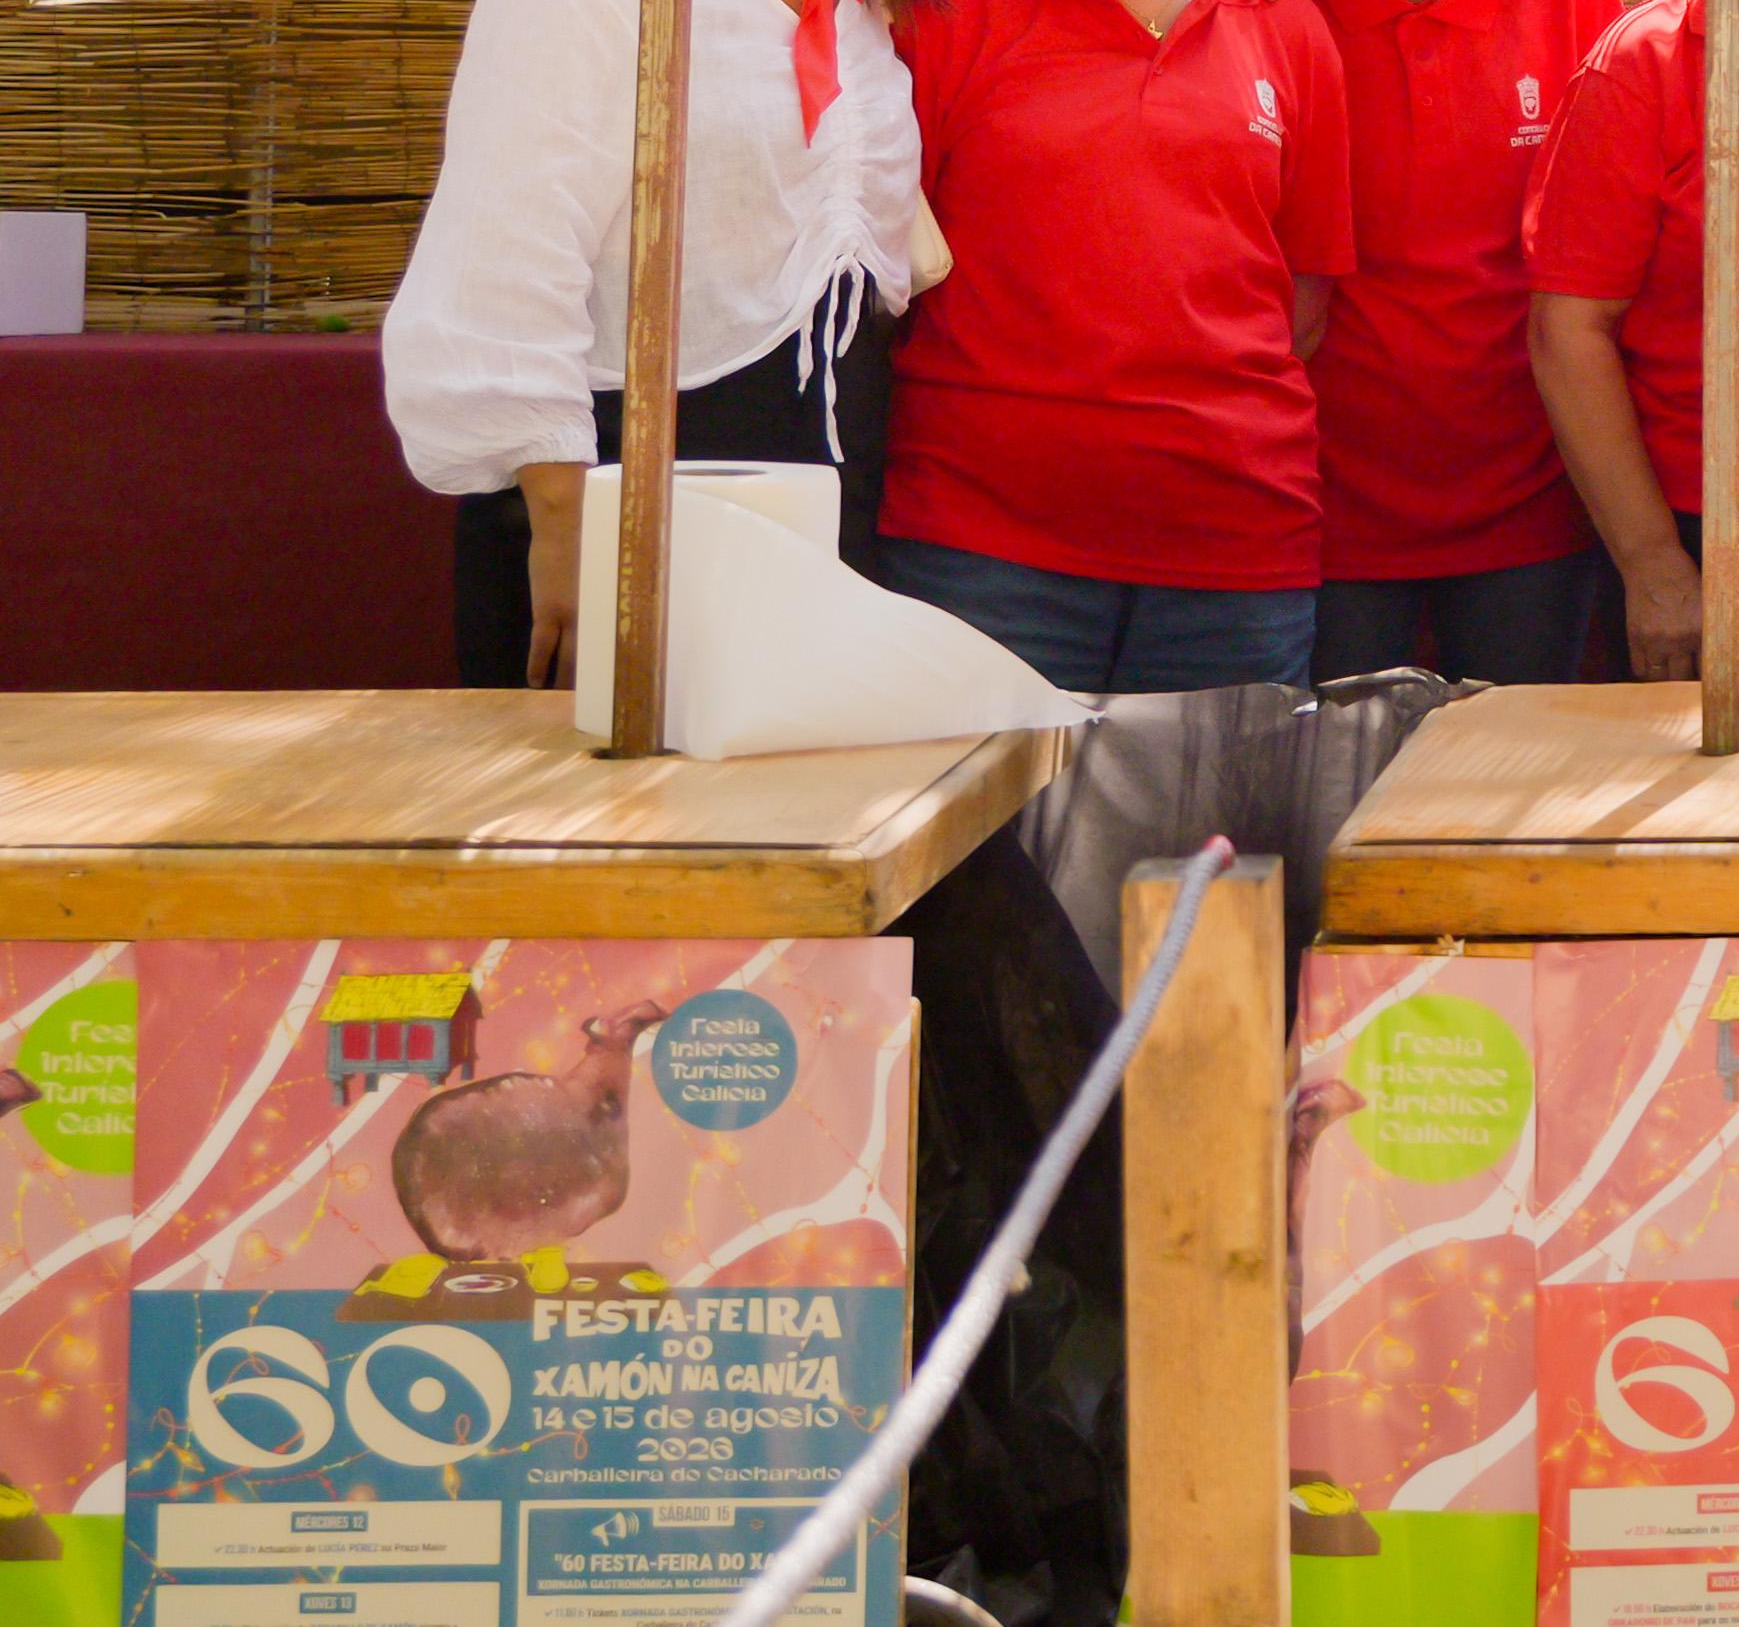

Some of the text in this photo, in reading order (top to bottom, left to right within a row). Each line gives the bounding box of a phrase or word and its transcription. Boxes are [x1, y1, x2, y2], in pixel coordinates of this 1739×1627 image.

[71, 1021, 134, 1043] Fes
[692, 1018, 760, 1035] Festa
[682, 1084, 766, 1101] Galicia
[532, 1296, 842, 1342] FESTA-FEIRA
[663, 1335, 713, 1361] DO
[532, 1353, 673, 1400] XAMÓN
[681, 1364, 720, 1392] NA
[189, 1323, 511, 1468] 60
[532, 1403, 839, 1433] 14 e 15 de agosto
[638, 1436, 734, 1462] 2026
[527, 1466, 842, 1484] Carballeira do Cacharado
[590, 1553, 712, 1573] FESTA-FEIRA
[718, 1553, 745, 1571] DO
